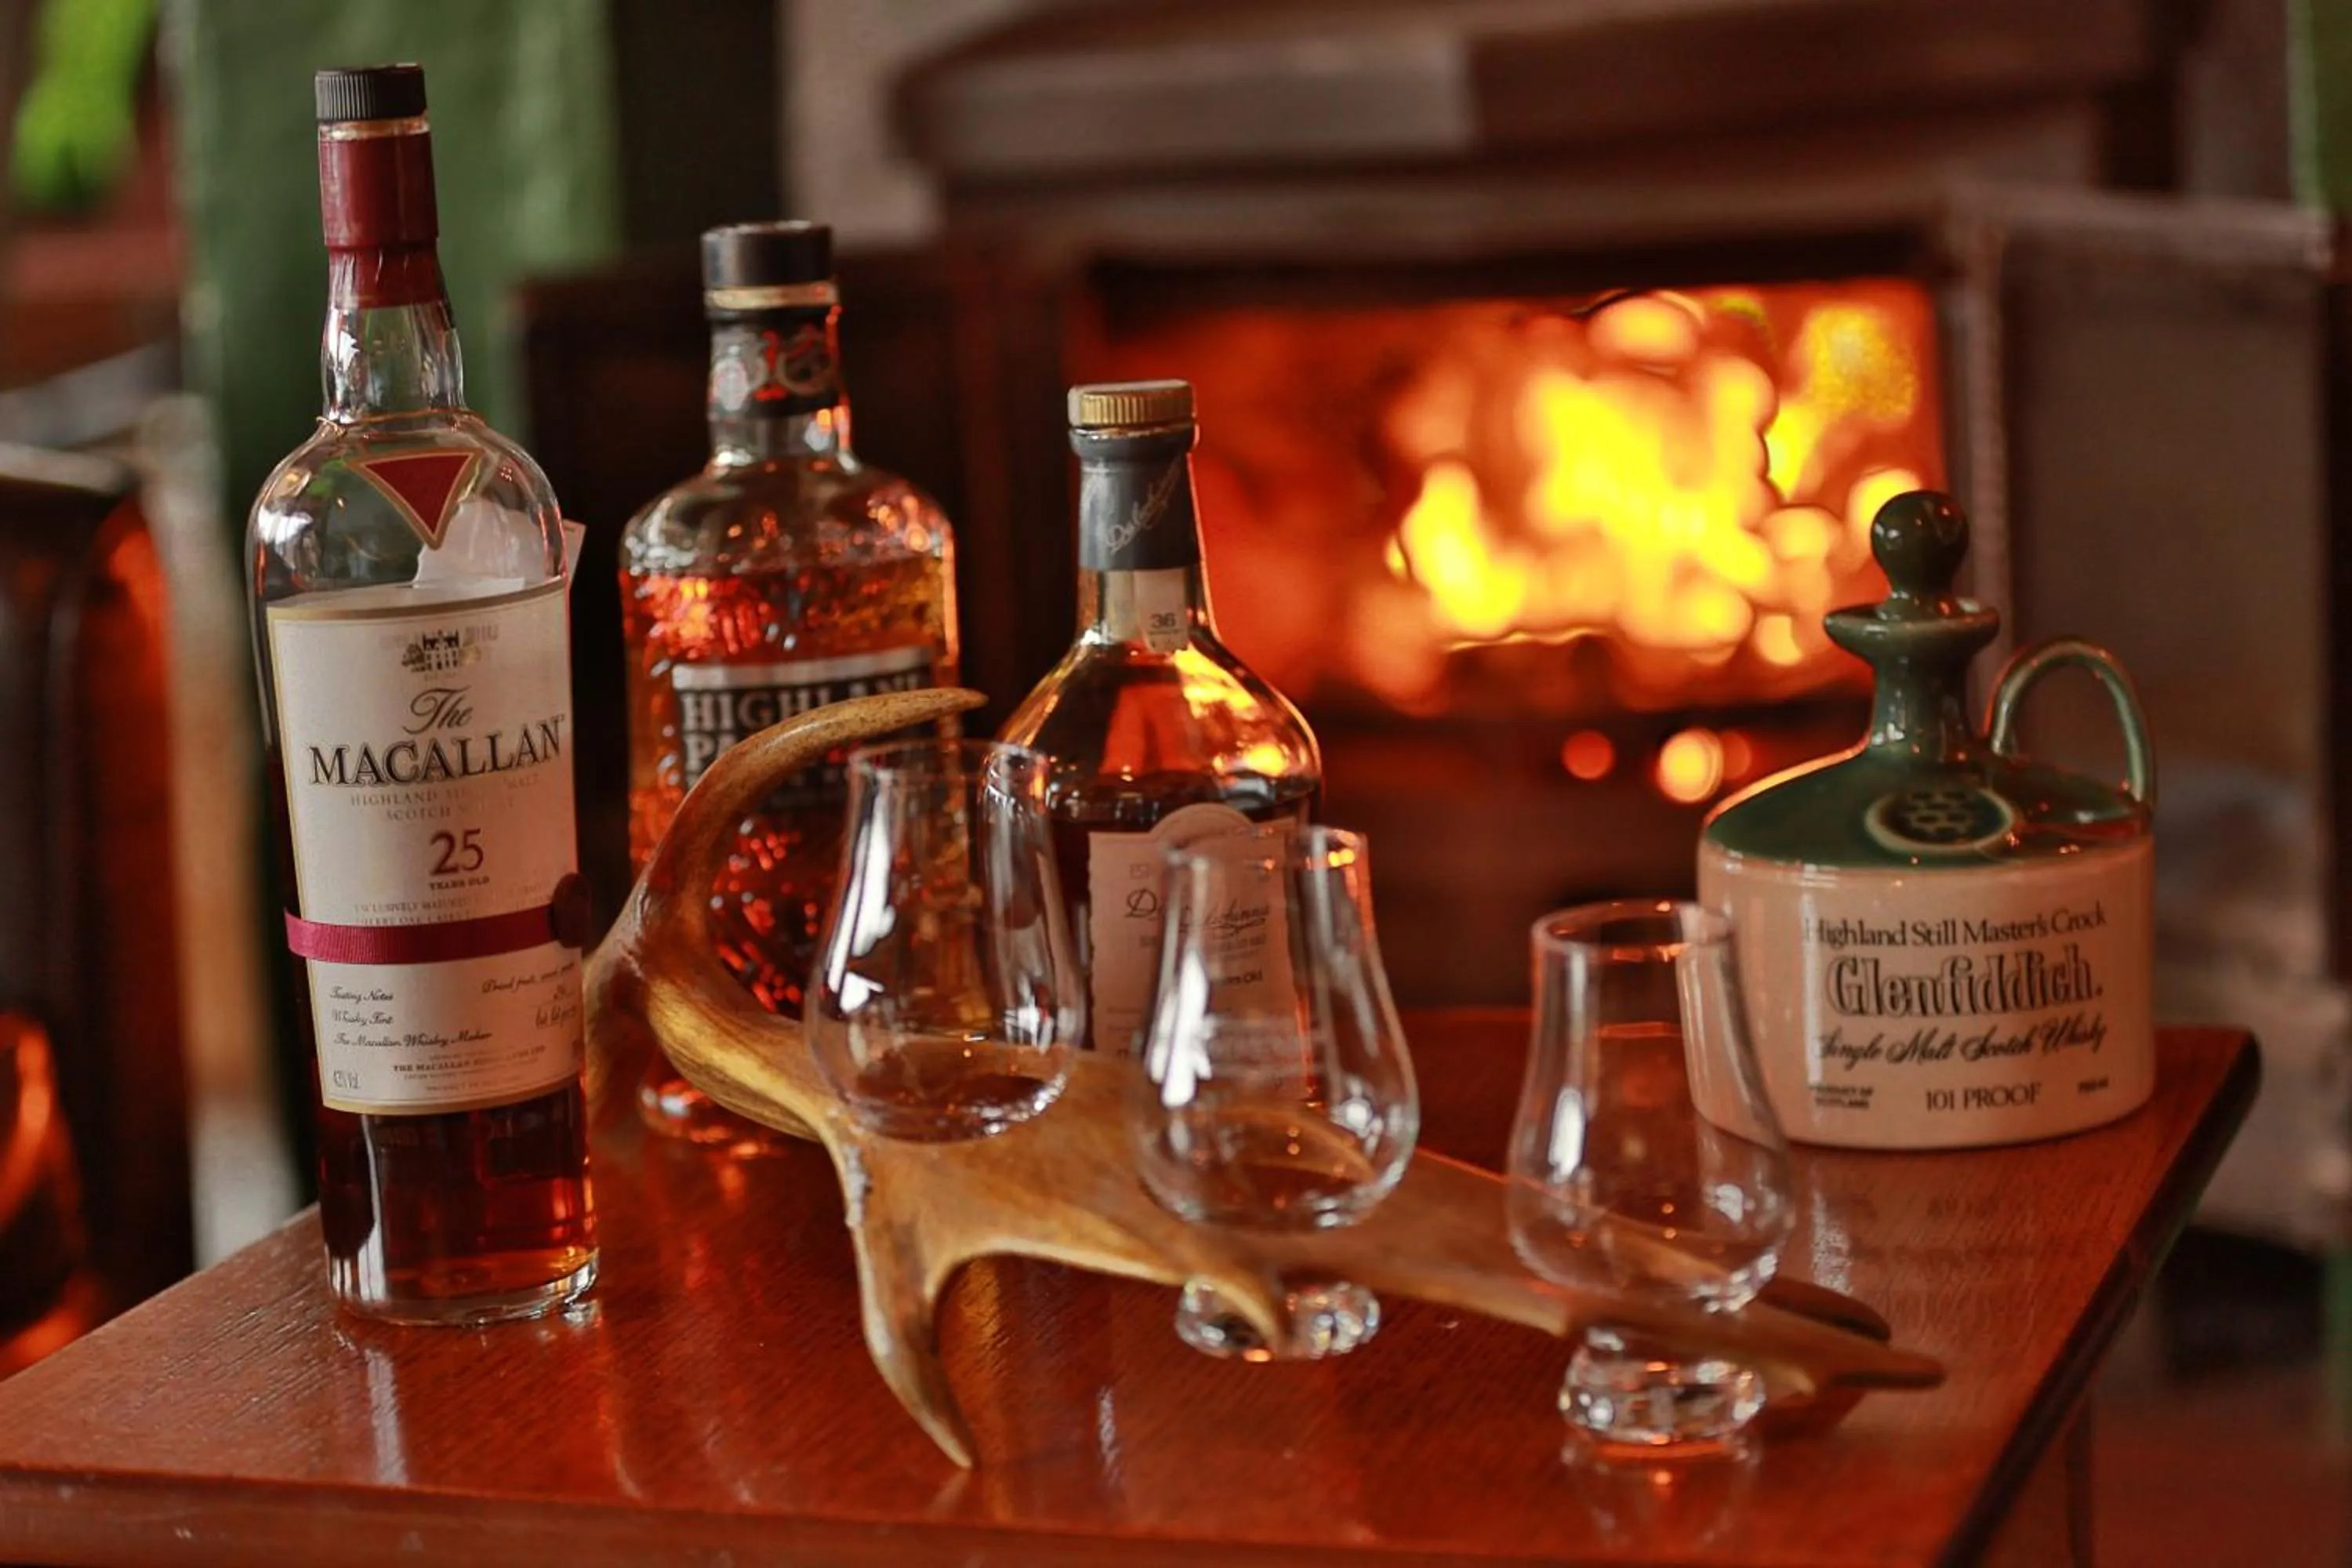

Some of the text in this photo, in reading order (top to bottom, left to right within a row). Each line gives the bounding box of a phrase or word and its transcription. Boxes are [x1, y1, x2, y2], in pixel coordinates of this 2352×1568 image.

[1151, 612, 1177, 630] 36
[401, 685, 474, 735] The
[307, 718, 563, 787] MACALLAN
[350, 789, 437, 807] HIGHLAND
[386, 805, 451, 821] SCOTCH
[429, 827, 485, 876] 25
[429, 876, 490, 891] YEARS OLD
[1911, 917, 1958, 947] Still
[1962, 912, 2050, 946] Master's
[2051, 899, 2107, 933] Crock
[1826, 942, 2105, 1017] Glenfiddich.
[363, 989, 394, 1000] Notes
[403, 1033, 448, 1048] Whisky
[1816, 1011, 2107, 1070] Single Malt Scotch Whisky
[1925, 1083, 2042, 1112] 101 PROOF
